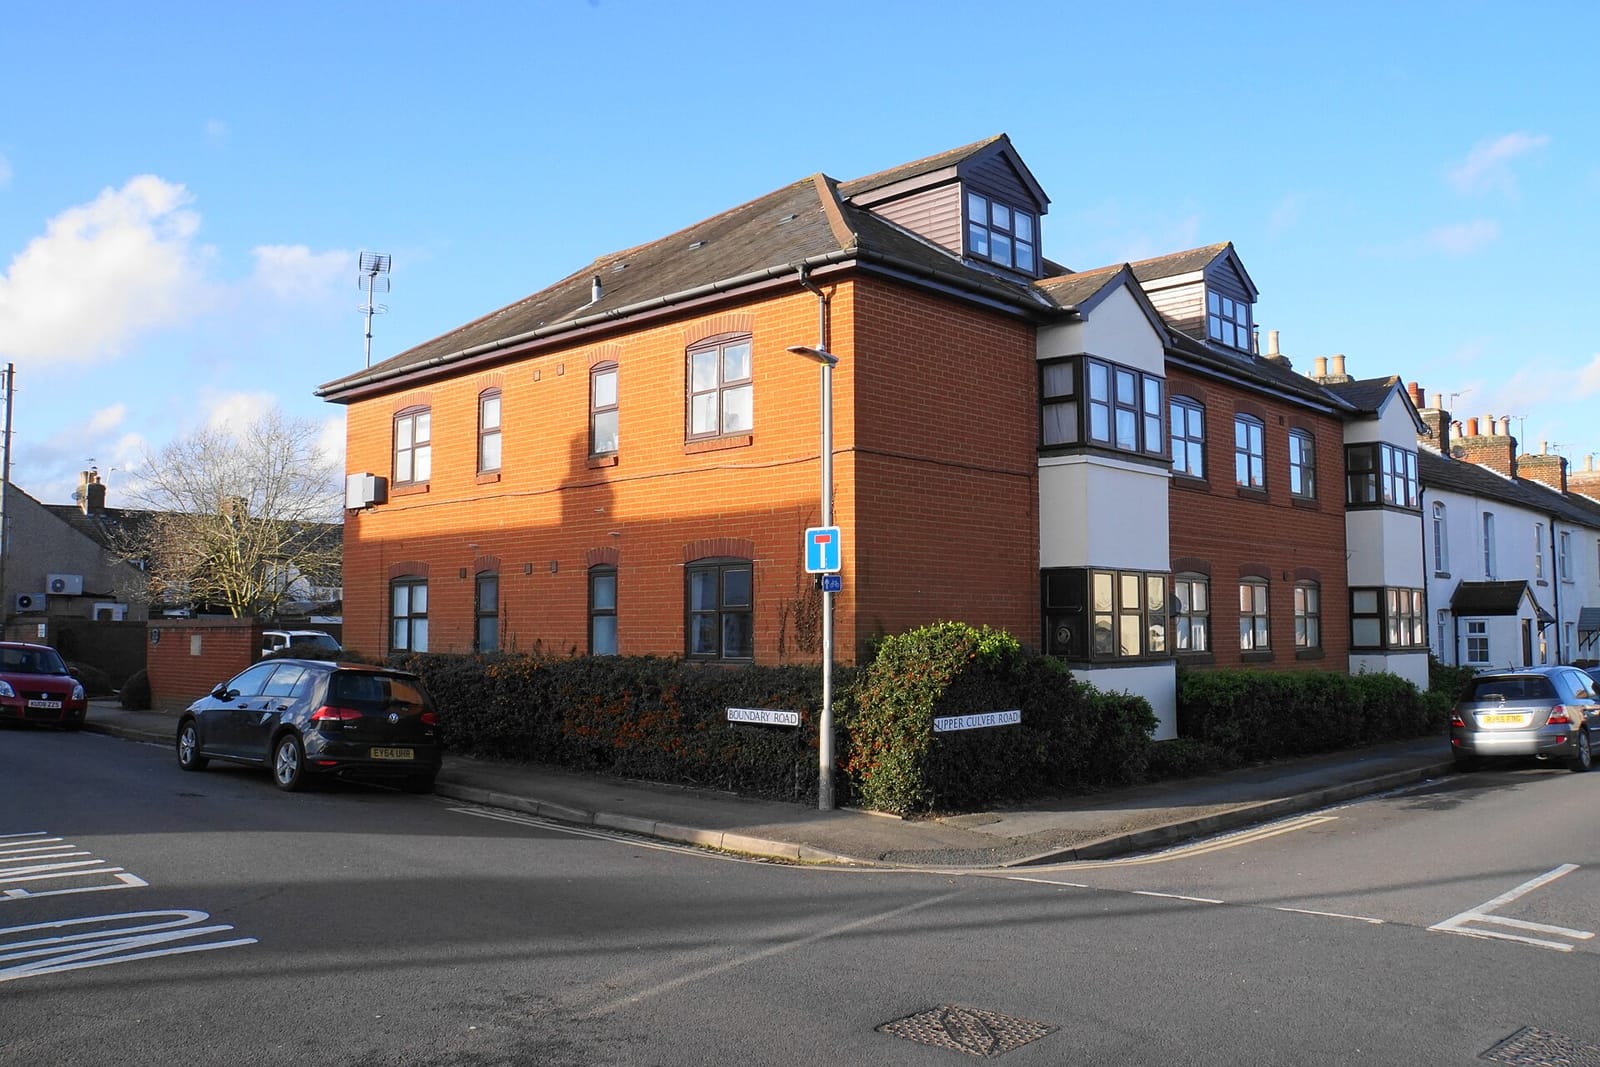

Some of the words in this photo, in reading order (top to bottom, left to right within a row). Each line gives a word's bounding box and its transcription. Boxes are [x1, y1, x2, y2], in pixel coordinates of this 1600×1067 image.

[728, 709, 770, 722] BOUNDARY
[774, 712, 797, 724] ROAD
[936, 717, 965, 730] UPPER
[966, 714, 997, 727] CULVER
[998, 711, 1018, 723] ROAD
[373, 748, 394, 758] EY64
